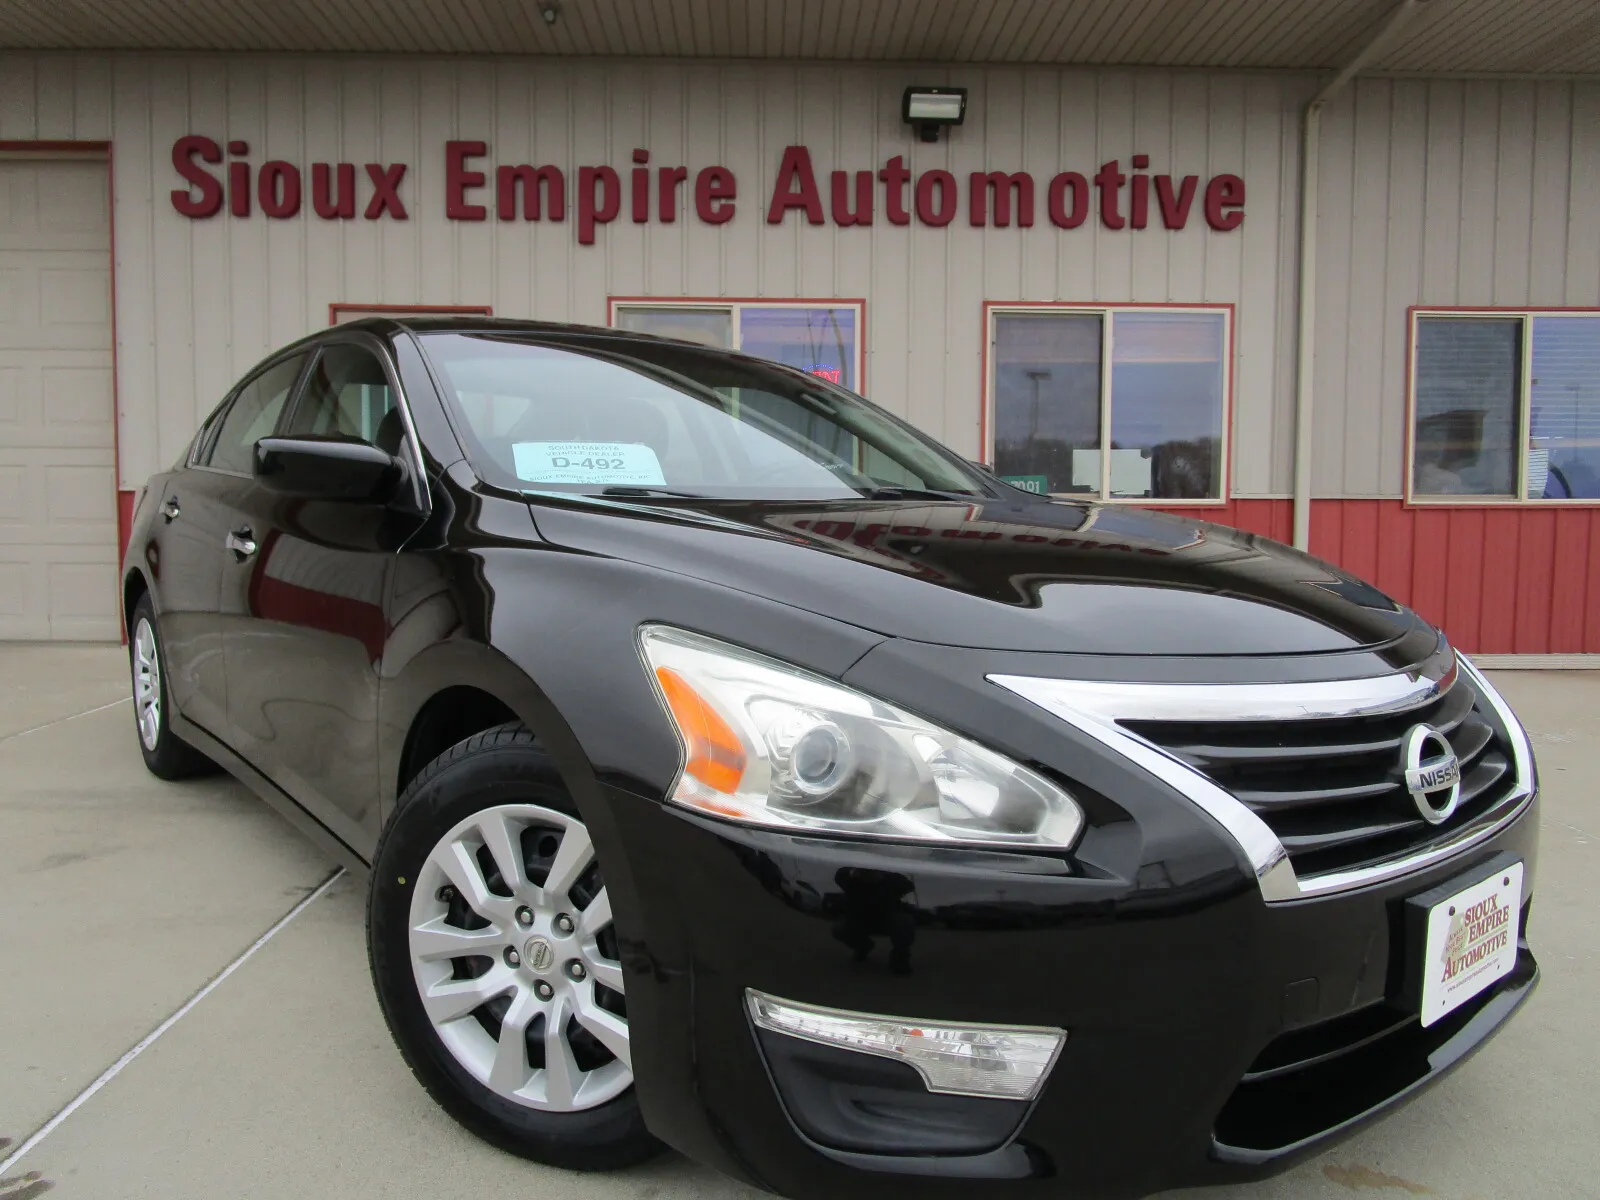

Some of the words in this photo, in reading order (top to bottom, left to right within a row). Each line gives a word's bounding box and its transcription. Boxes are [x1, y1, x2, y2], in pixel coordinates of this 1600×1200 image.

[171, 135, 408, 219] Sioux
[445, 140, 736, 245] Empire
[767, 145, 1245, 231] Automotive
[551, 457, 626, 470] D-492
[1464, 893, 1498, 927] SIOUX
[1467, 904, 1510, 943] EMPIRE
[1441, 930, 1508, 983] AUTOMOTIVE
